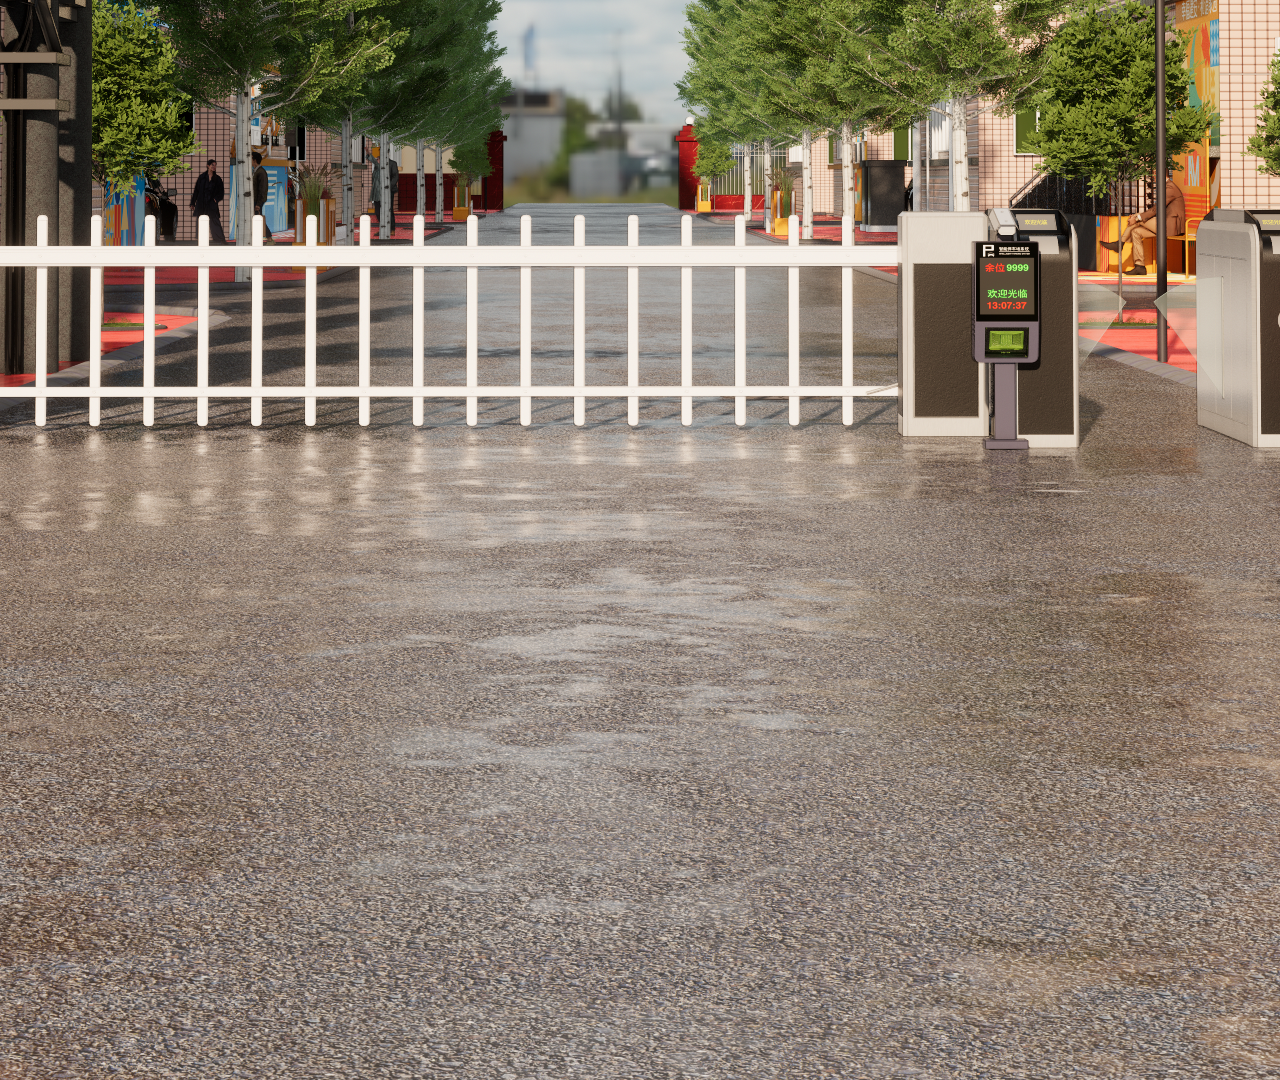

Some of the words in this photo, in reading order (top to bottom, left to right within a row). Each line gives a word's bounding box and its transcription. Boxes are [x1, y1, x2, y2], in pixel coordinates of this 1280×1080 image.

[985, 263, 1005, 272] 余位
[1006, 263, 1029, 272] 9999
[987, 289, 1028, 299] 欢迎光临
[986, 301, 1027, 310] 13:07:37
